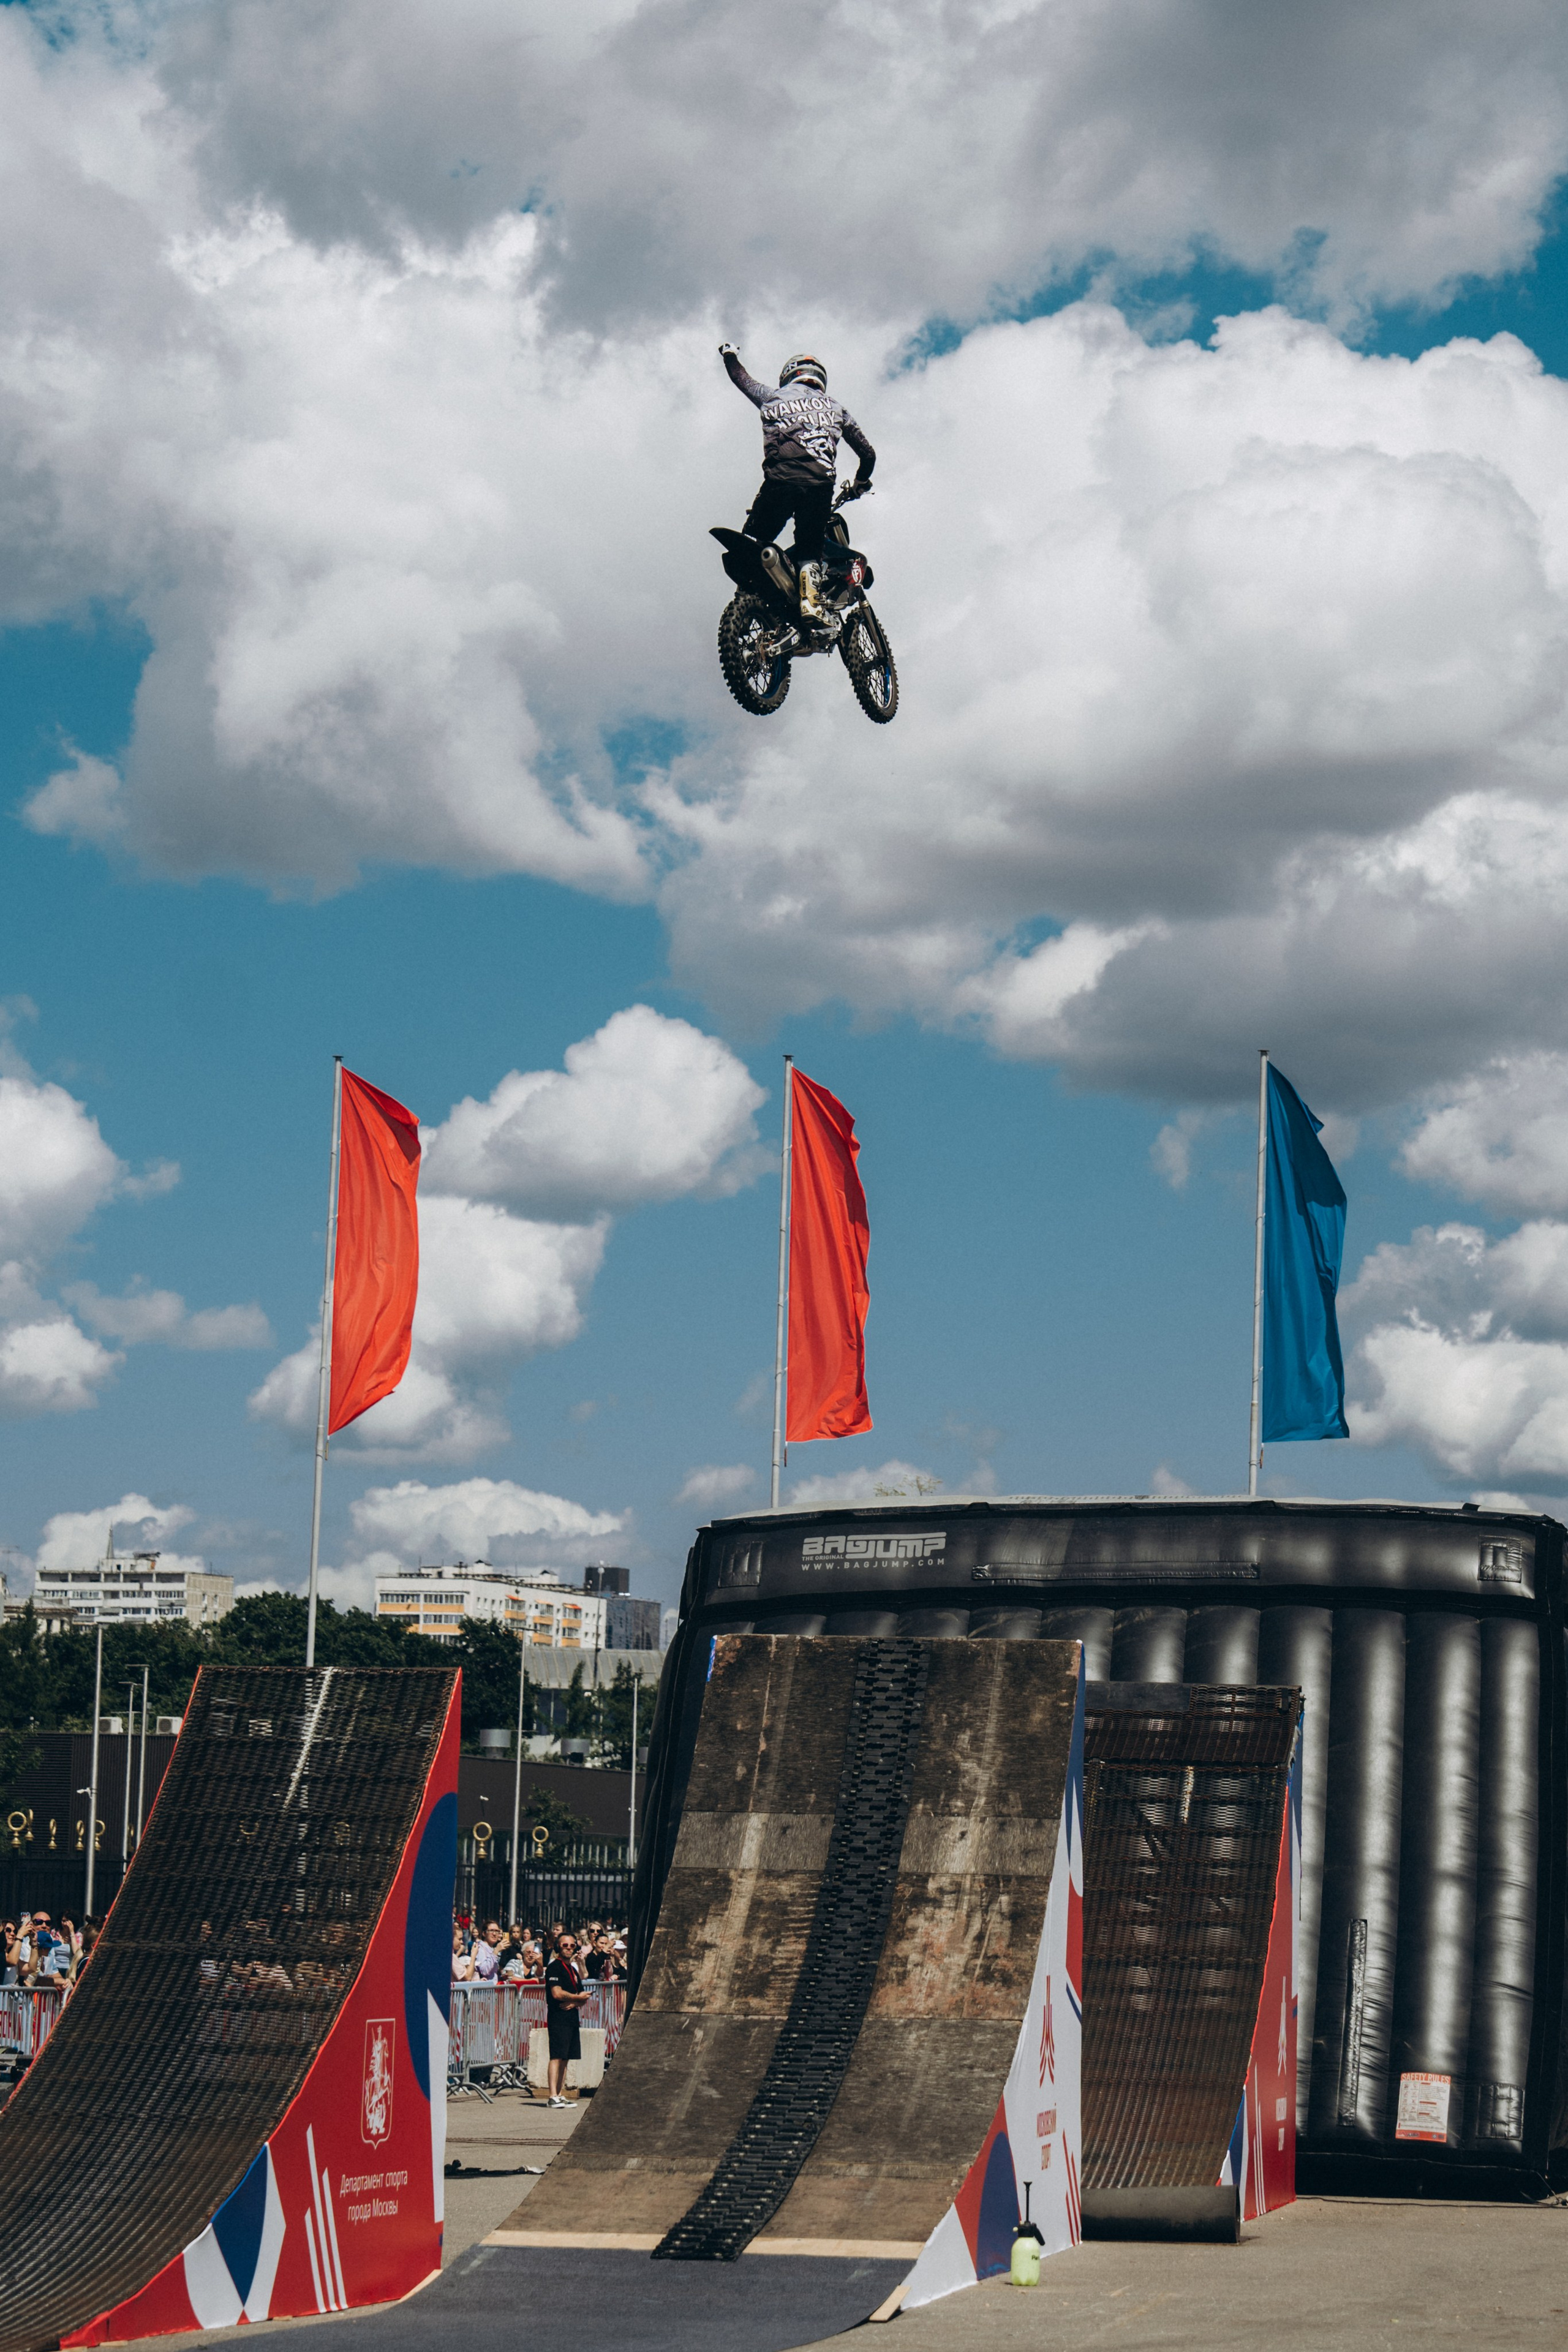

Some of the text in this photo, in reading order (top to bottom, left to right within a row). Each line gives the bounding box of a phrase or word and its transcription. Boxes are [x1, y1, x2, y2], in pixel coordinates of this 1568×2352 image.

[763, 398, 832, 420] IVANKOV
[802, 1532, 946, 1559] BAGJUMP
[801, 1558, 944, 1571] WWW.BAGJUMP.COM
[1403, 2073, 1449, 2084] SAFETY RULES
[340, 2170, 408, 2198] Департамент спорта
[348, 2198, 398, 2226] города Москвы
